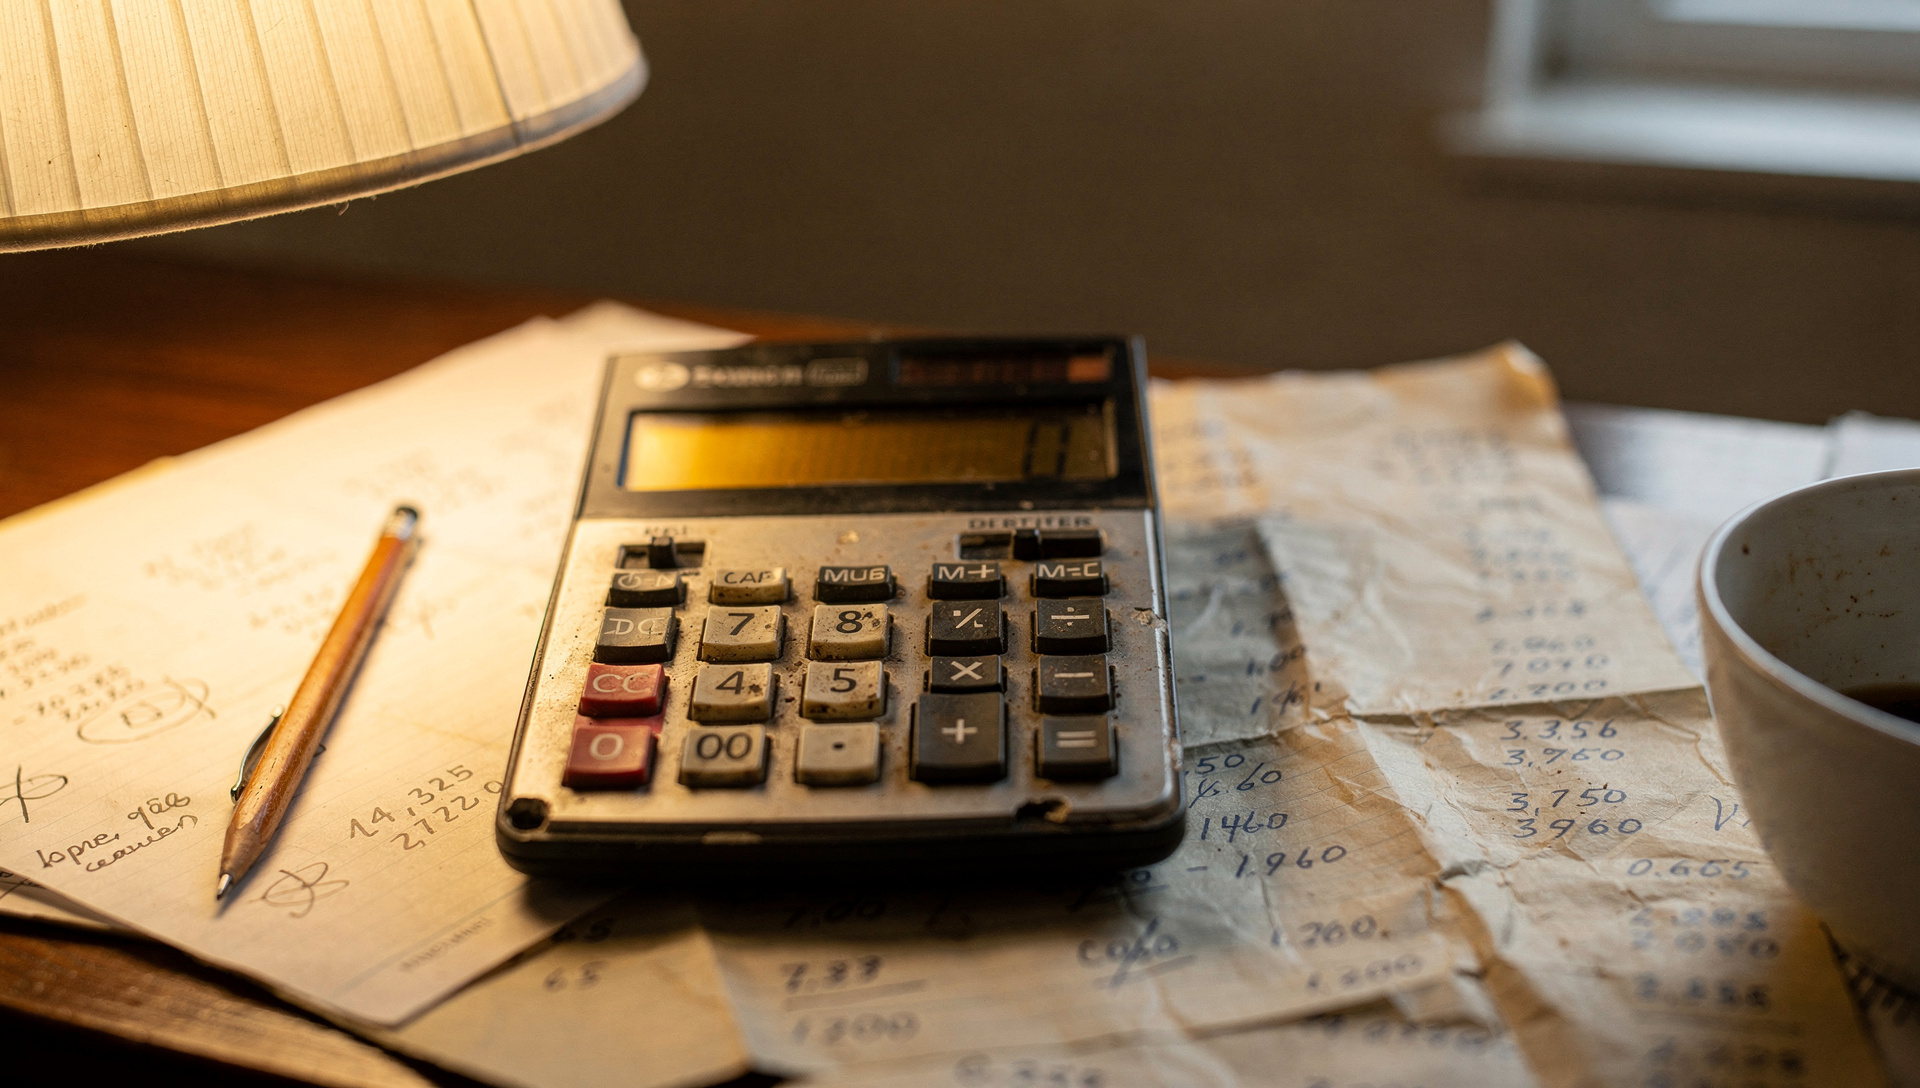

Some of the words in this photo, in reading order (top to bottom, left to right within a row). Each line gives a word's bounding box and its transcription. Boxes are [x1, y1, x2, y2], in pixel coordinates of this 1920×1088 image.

[938, 564, 995, 580] M+
[728, 612, 755, 636] 7
[835, 610, 863, 634] 8
[715, 670, 746, 695] 4
[830, 668, 857, 693] 5
